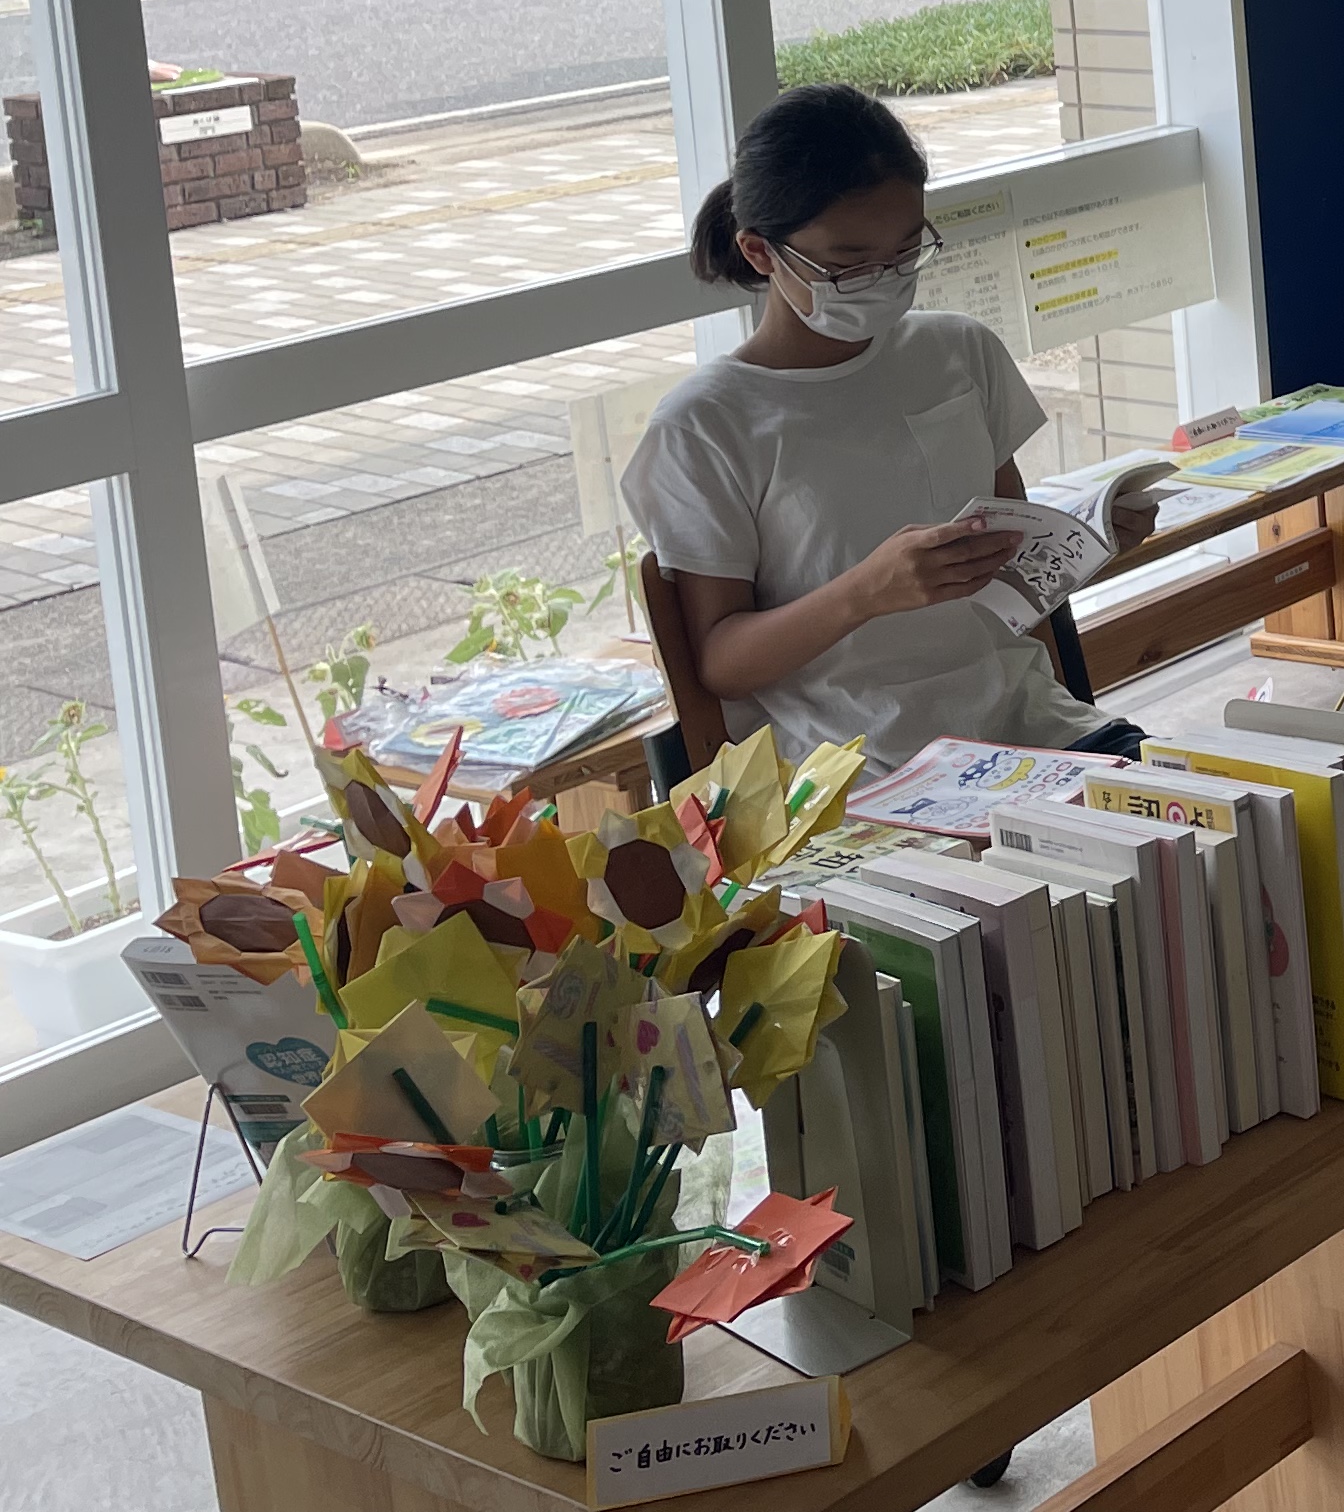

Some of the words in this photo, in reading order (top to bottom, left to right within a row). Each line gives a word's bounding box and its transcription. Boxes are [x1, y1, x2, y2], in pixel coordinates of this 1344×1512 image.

[608, 1422, 817, 1473] ご自由にお取りください
